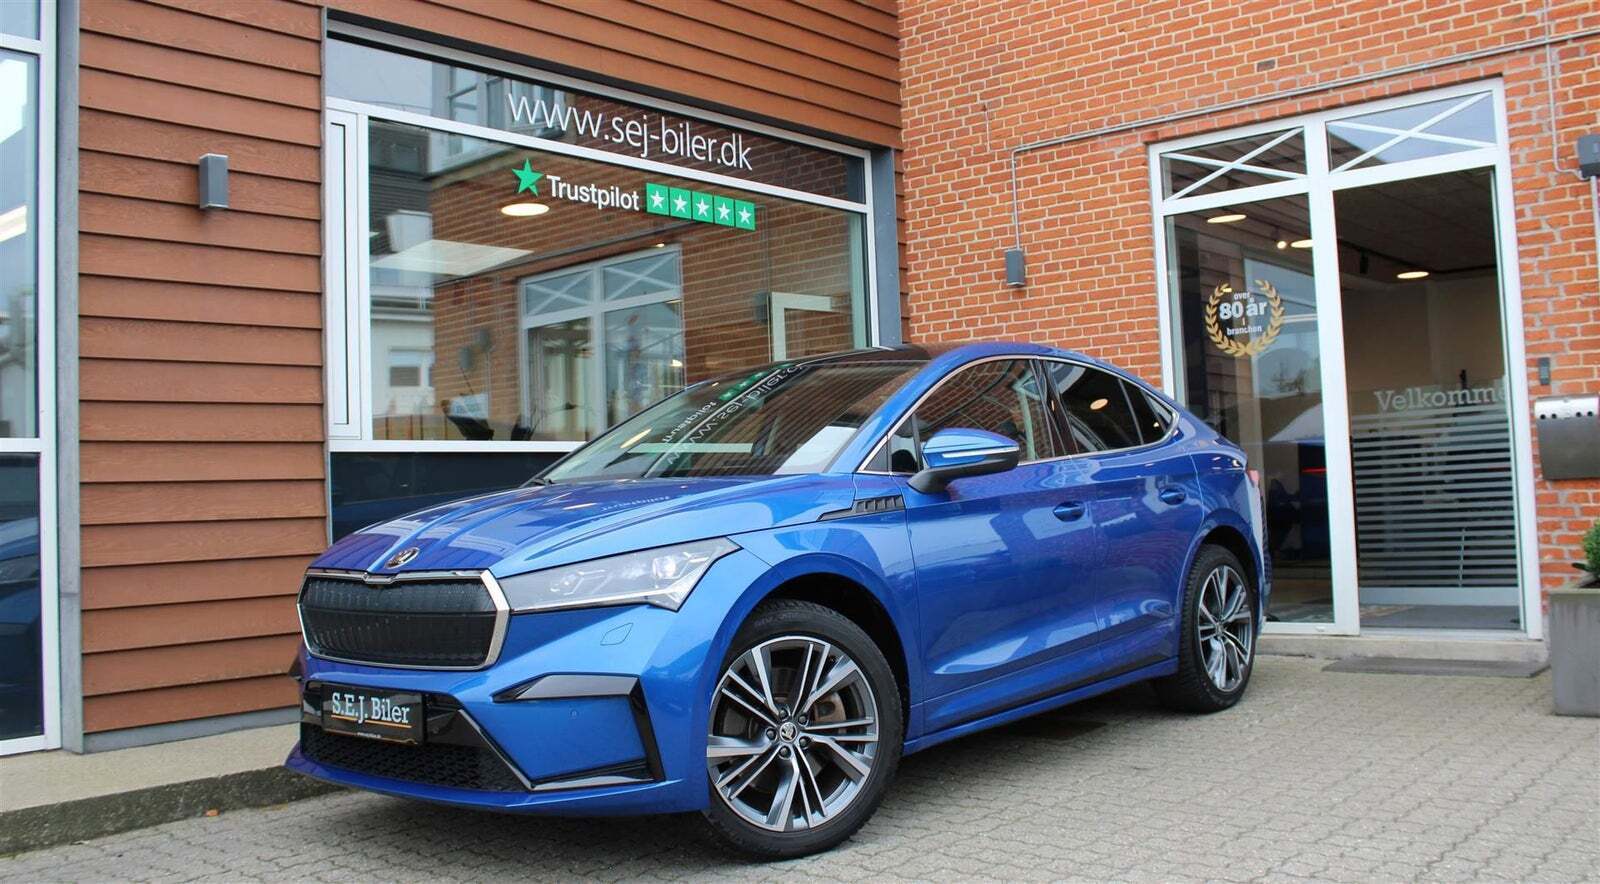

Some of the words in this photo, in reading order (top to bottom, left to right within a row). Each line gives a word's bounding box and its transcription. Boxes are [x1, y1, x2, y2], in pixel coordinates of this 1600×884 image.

[508, 93, 752, 170] www.sej-biler.dk
[546, 175, 640, 211] Trustpilot
[1219, 301, 1244, 320] 80
[1246, 297, 1268, 316] år
[1233, 291, 1250, 300] over
[1226, 325, 1263, 336] branchen
[332, 692, 368, 723] S.E.J.
[371, 697, 410, 723] Biler
